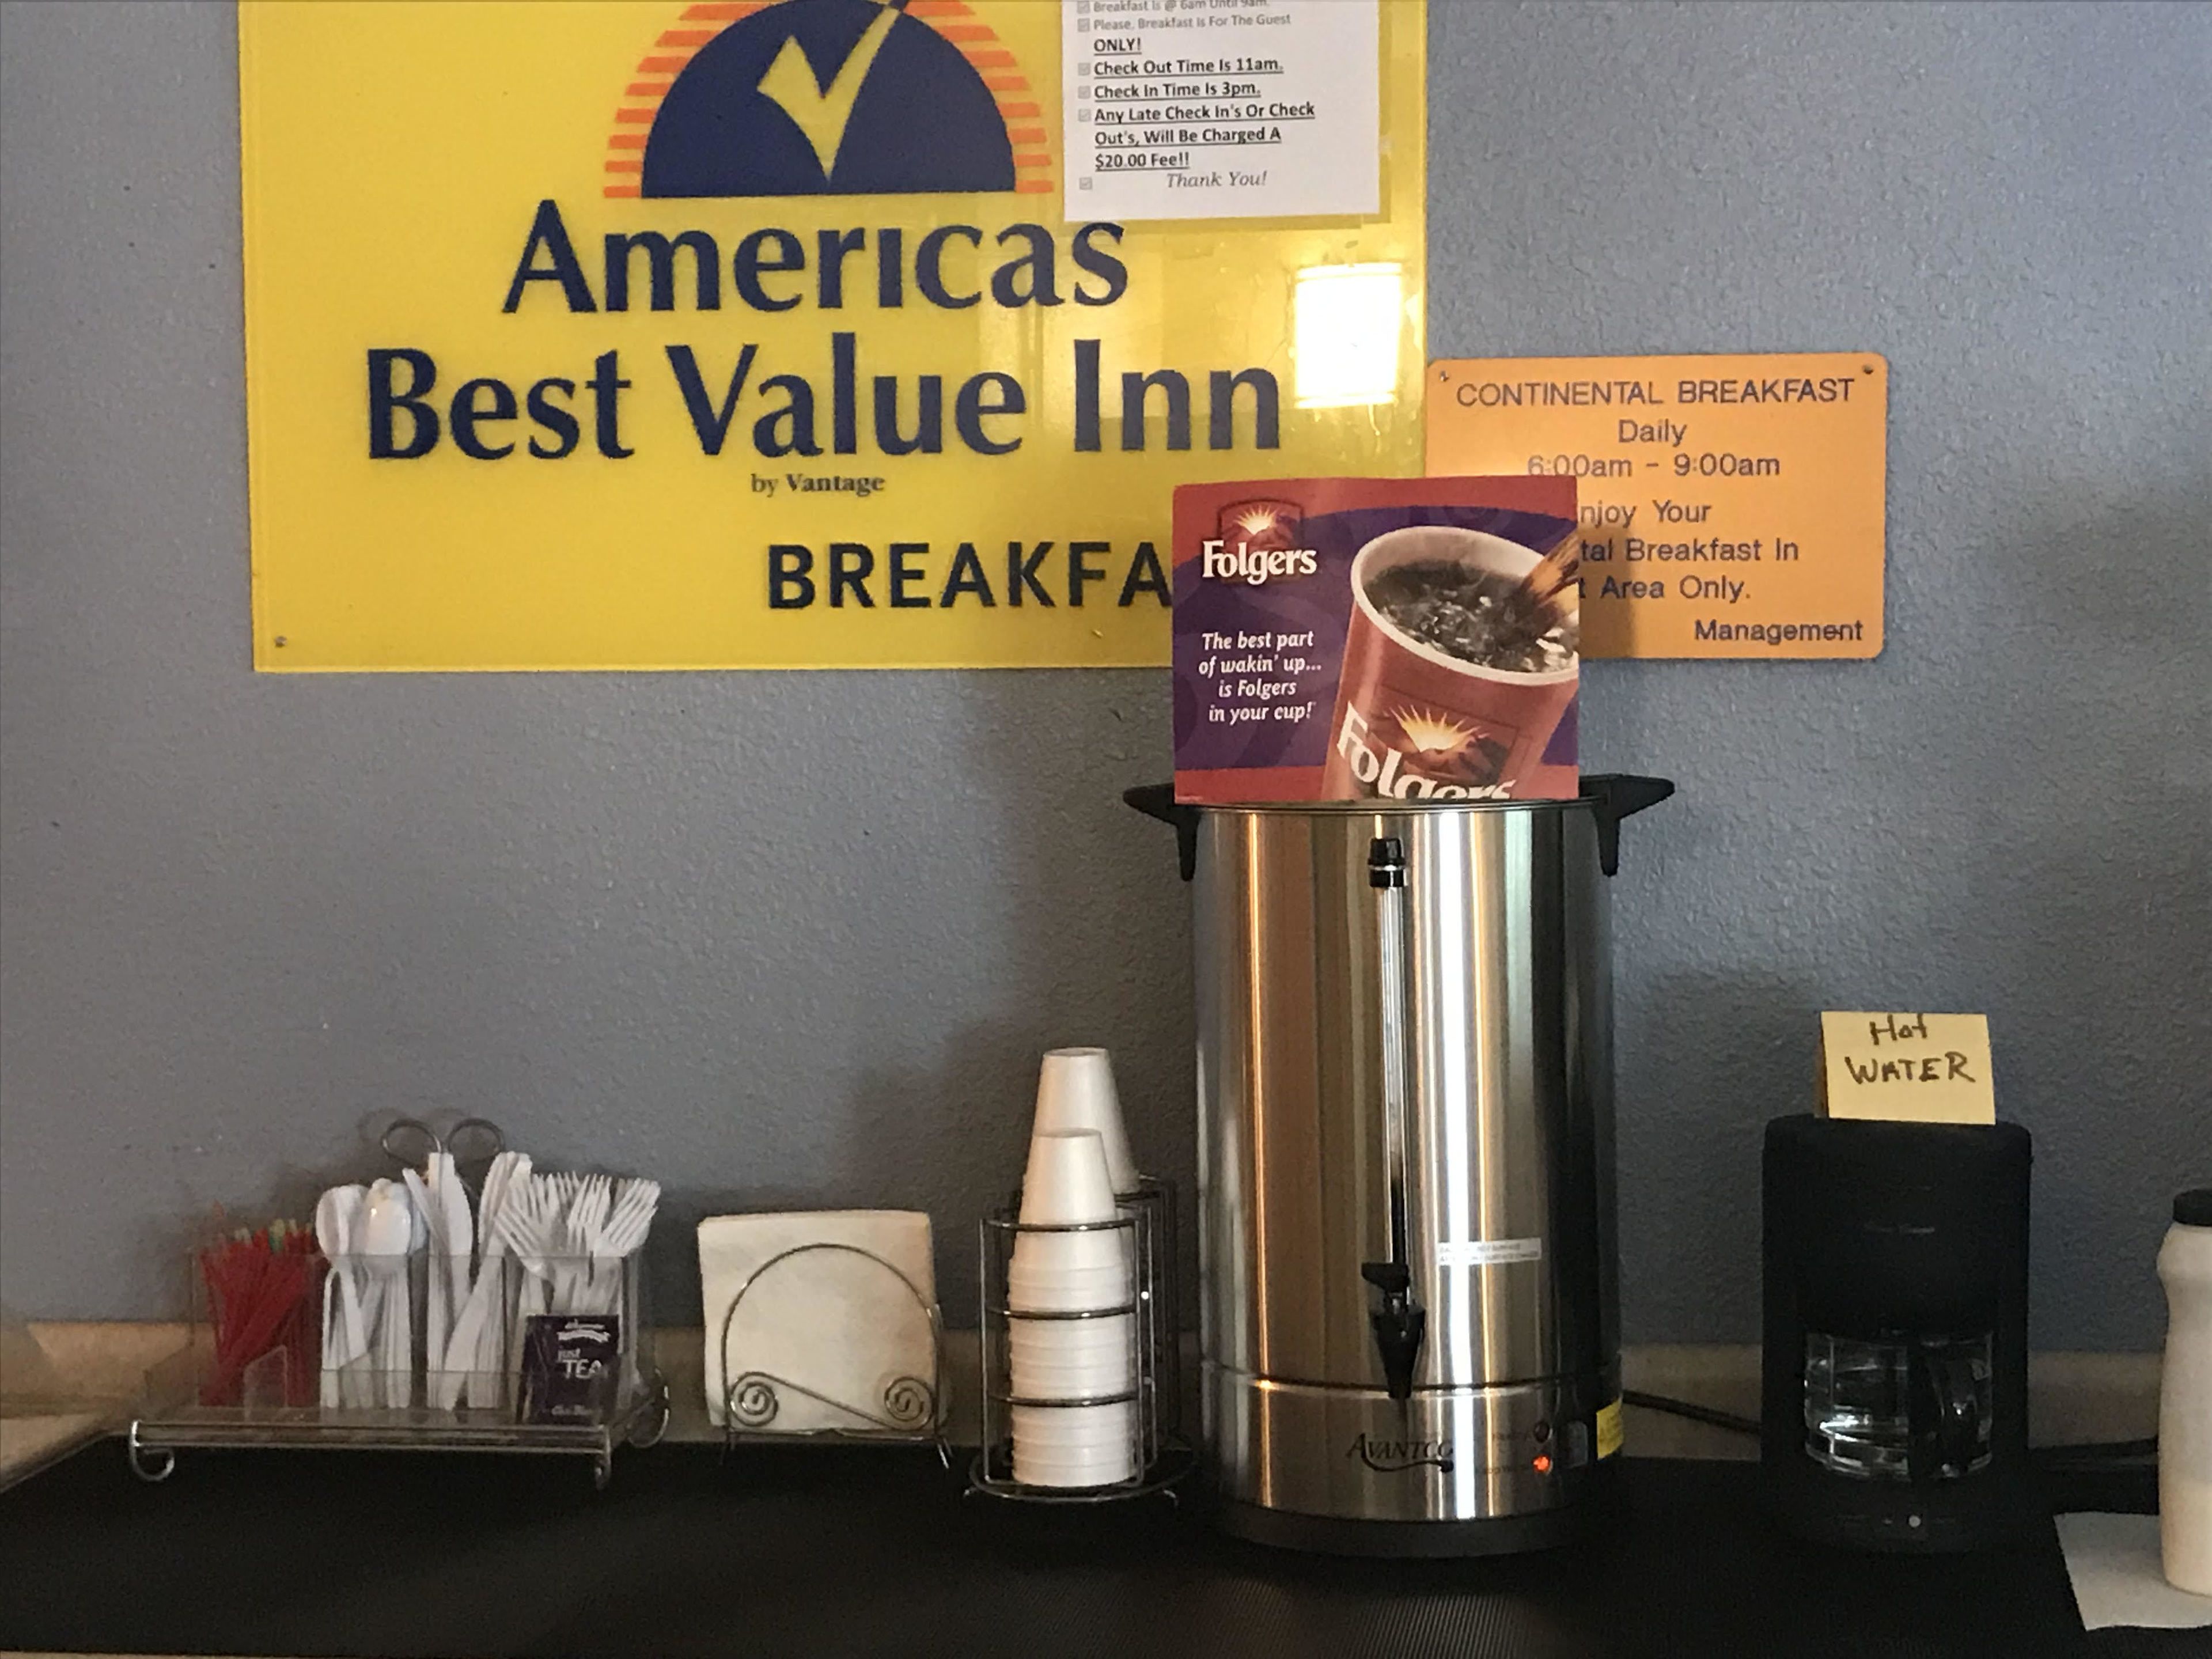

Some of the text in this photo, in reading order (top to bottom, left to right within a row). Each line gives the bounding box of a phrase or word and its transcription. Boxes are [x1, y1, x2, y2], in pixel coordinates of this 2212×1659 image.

[1094, 1, 1149, 12] Breakfast
[1165, 0, 1177, 12] @
[1181, 0, 1206, 10] 6am
[1138, 17, 1192, 28] Breakfast
[1209, 16, 1228, 26] For
[1231, 15, 1253, 26] The
[1256, 14, 1290, 25] Guest
[1094, 37, 1141, 52] ONLY!
[1094, 58, 1283, 75] Check Out Time Is 11am.
[1094, 82, 1261, 98] Check In Time Is 3pm.
[1094, 102, 1315, 123] Any Late Check In's Or Check
[1094, 127, 1281, 146] Out's, Will Be Charged A
[1095, 151, 1190, 170] $20.00 Fee!!
[1166, 170, 1268, 188] Thank You!
[501, 199, 1128, 313] Americas
[368, 332, 1281, 460] Best Value Inn
[1457, 377, 1855, 407] CONTINENTAL BREAKFAST
[1618, 418, 1688, 447] Daily
[1528, 453, 1633, 478] 6:00am
[1674, 452, 1781, 476] 9:00am
[751, 473, 885, 498] by Vantage
[1580, 499, 1712, 529] njoy Your
[1626, 537, 1763, 562] Breakfast
[1776, 537, 1799, 561] In
[768, 541, 1173, 609] BREAKFA
[1202, 539, 1318, 586] Folgers
[1600, 575, 1665, 599] Area
[1679, 574, 1751, 604] Only.
[1202, 630, 1314, 652] The best part
[1694, 618, 1863, 646] Management
[1198, 654, 1322, 679] of wakin' up...
[1218, 677, 1297, 700] is Folgers
[1209, 701, 1313, 726] in your cup!
[1844, 1051, 1976, 1085] WATER
[562, 1359, 609, 1379] TEA
